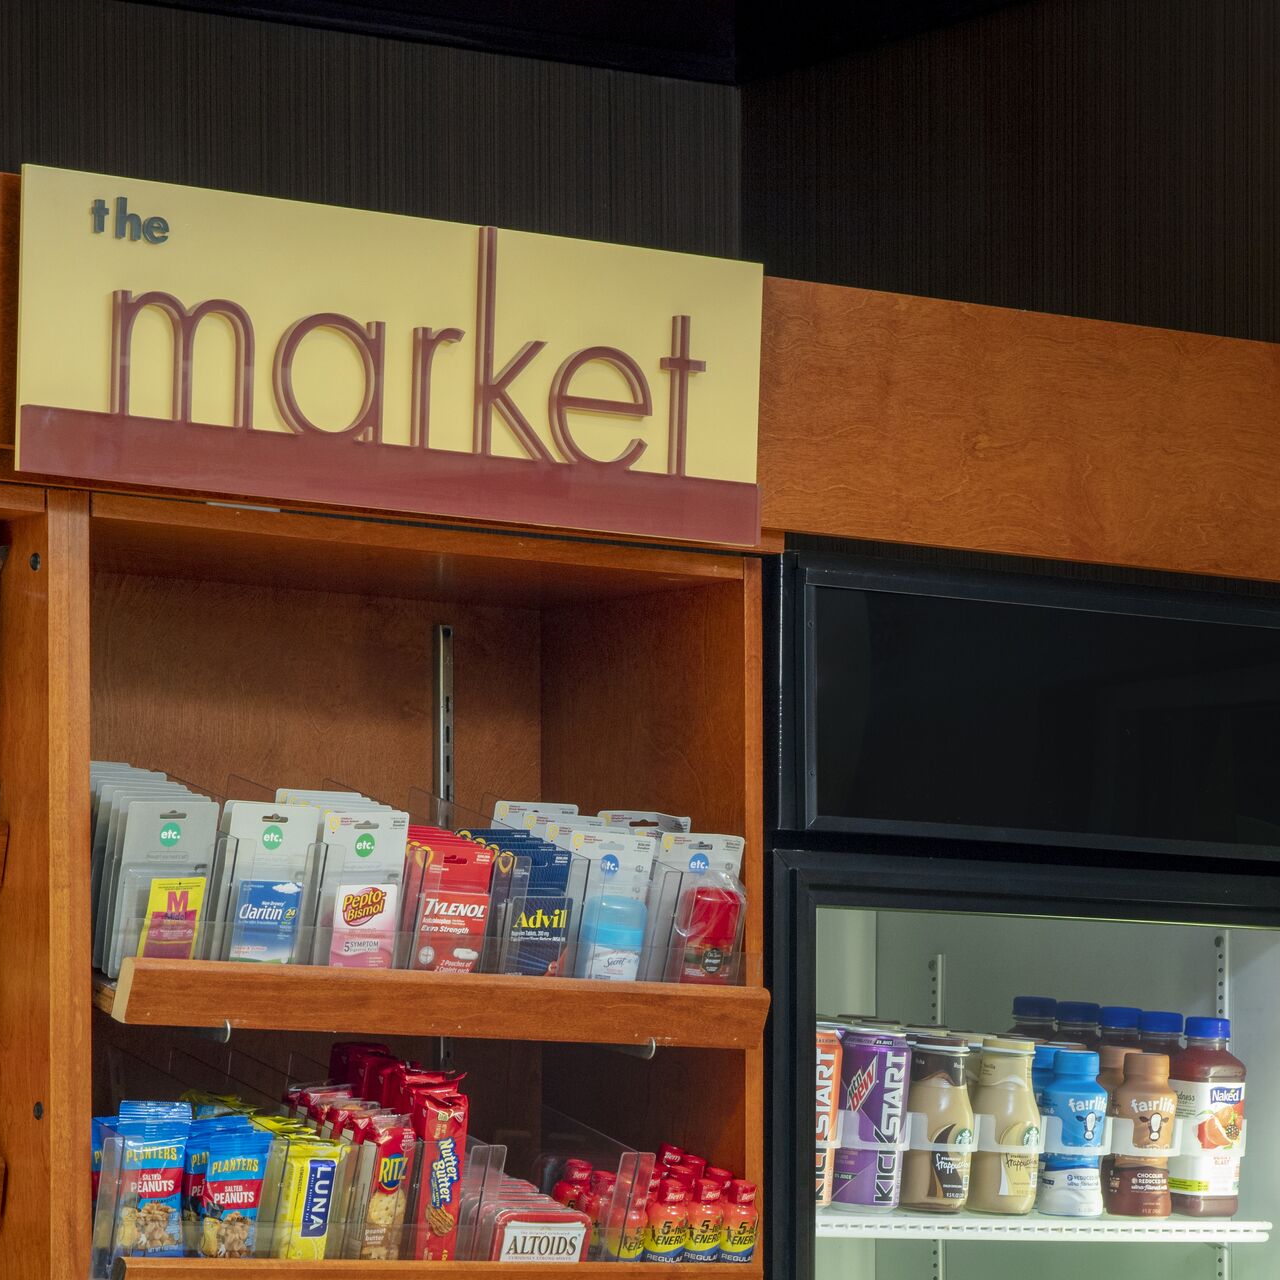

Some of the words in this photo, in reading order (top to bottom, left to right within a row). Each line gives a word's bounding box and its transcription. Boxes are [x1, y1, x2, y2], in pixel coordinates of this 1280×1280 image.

[91, 197, 169, 244] the
[110, 226, 707, 477] market
[161, 830, 180, 840] etc.
[263, 833, 282, 842] etc.
[356, 841, 374, 850] etc.
[239, 904, 282, 920] Claritin
[348, 900, 384, 921] Bismol
[424, 899, 486, 917] TYLENOL
[513, 909, 567, 928] Advil
[439, 926, 469, 934] Strength
[126, 1147, 177, 1163] PLANTERS
[439, 1139, 457, 1181] Nutter
[665, 1152, 680, 1161] Berry
[212, 1159, 258, 1174] PLANTERS
[379, 1157, 408, 1182] RITZ
[131, 1180, 174, 1192] PEANUTS
[433, 1162, 450, 1202] Butter
[214, 1192, 254, 1204] PEANUTS
[310, 1167, 331, 1230] LUNA
[506, 1237, 578, 1256] ALTOIDS
